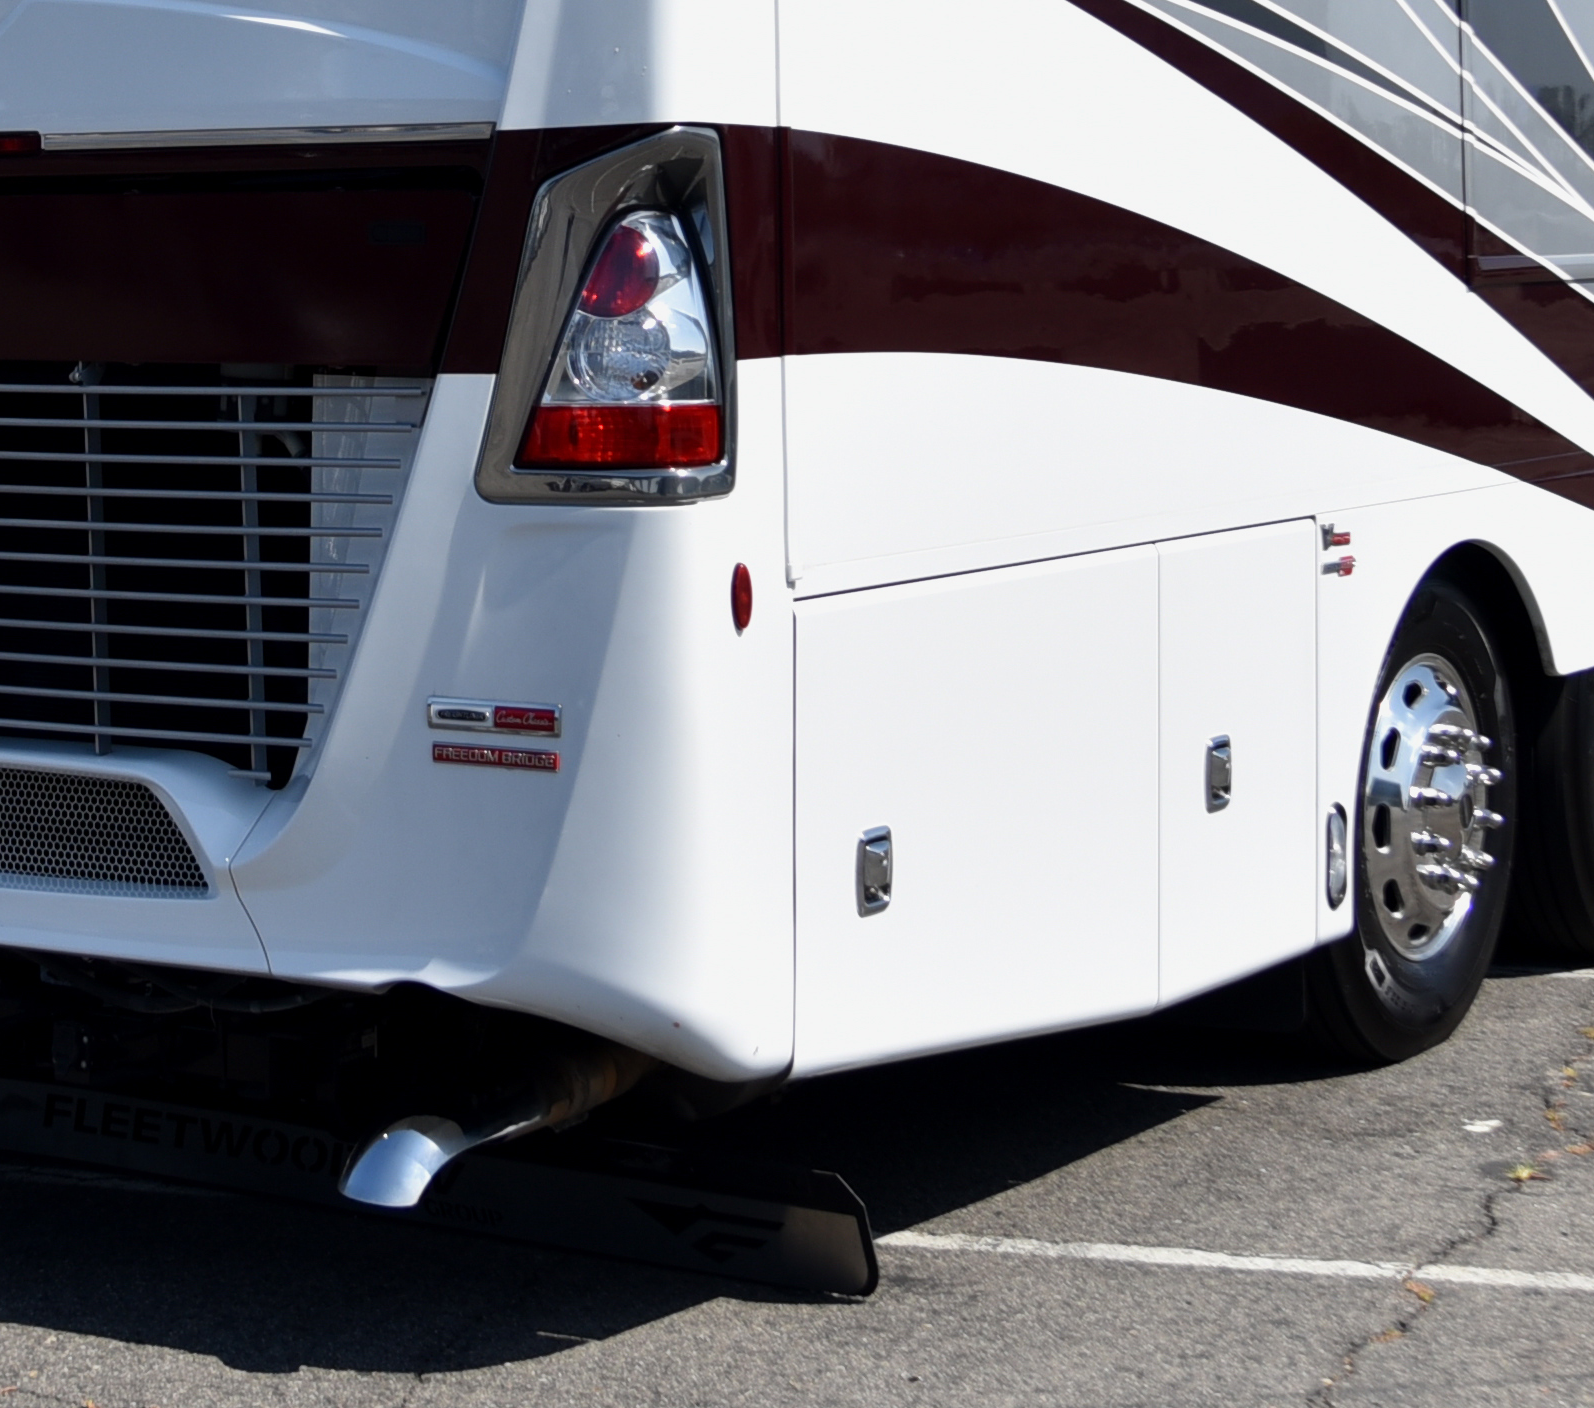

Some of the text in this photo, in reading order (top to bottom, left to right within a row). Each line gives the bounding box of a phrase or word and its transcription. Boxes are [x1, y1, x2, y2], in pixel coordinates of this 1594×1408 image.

[434, 746, 555, 768] FREEDOM BRIDGE
[43, 1092, 352, 1178] FLEETWOO
[423, 1198, 504, 1226] GROUP
